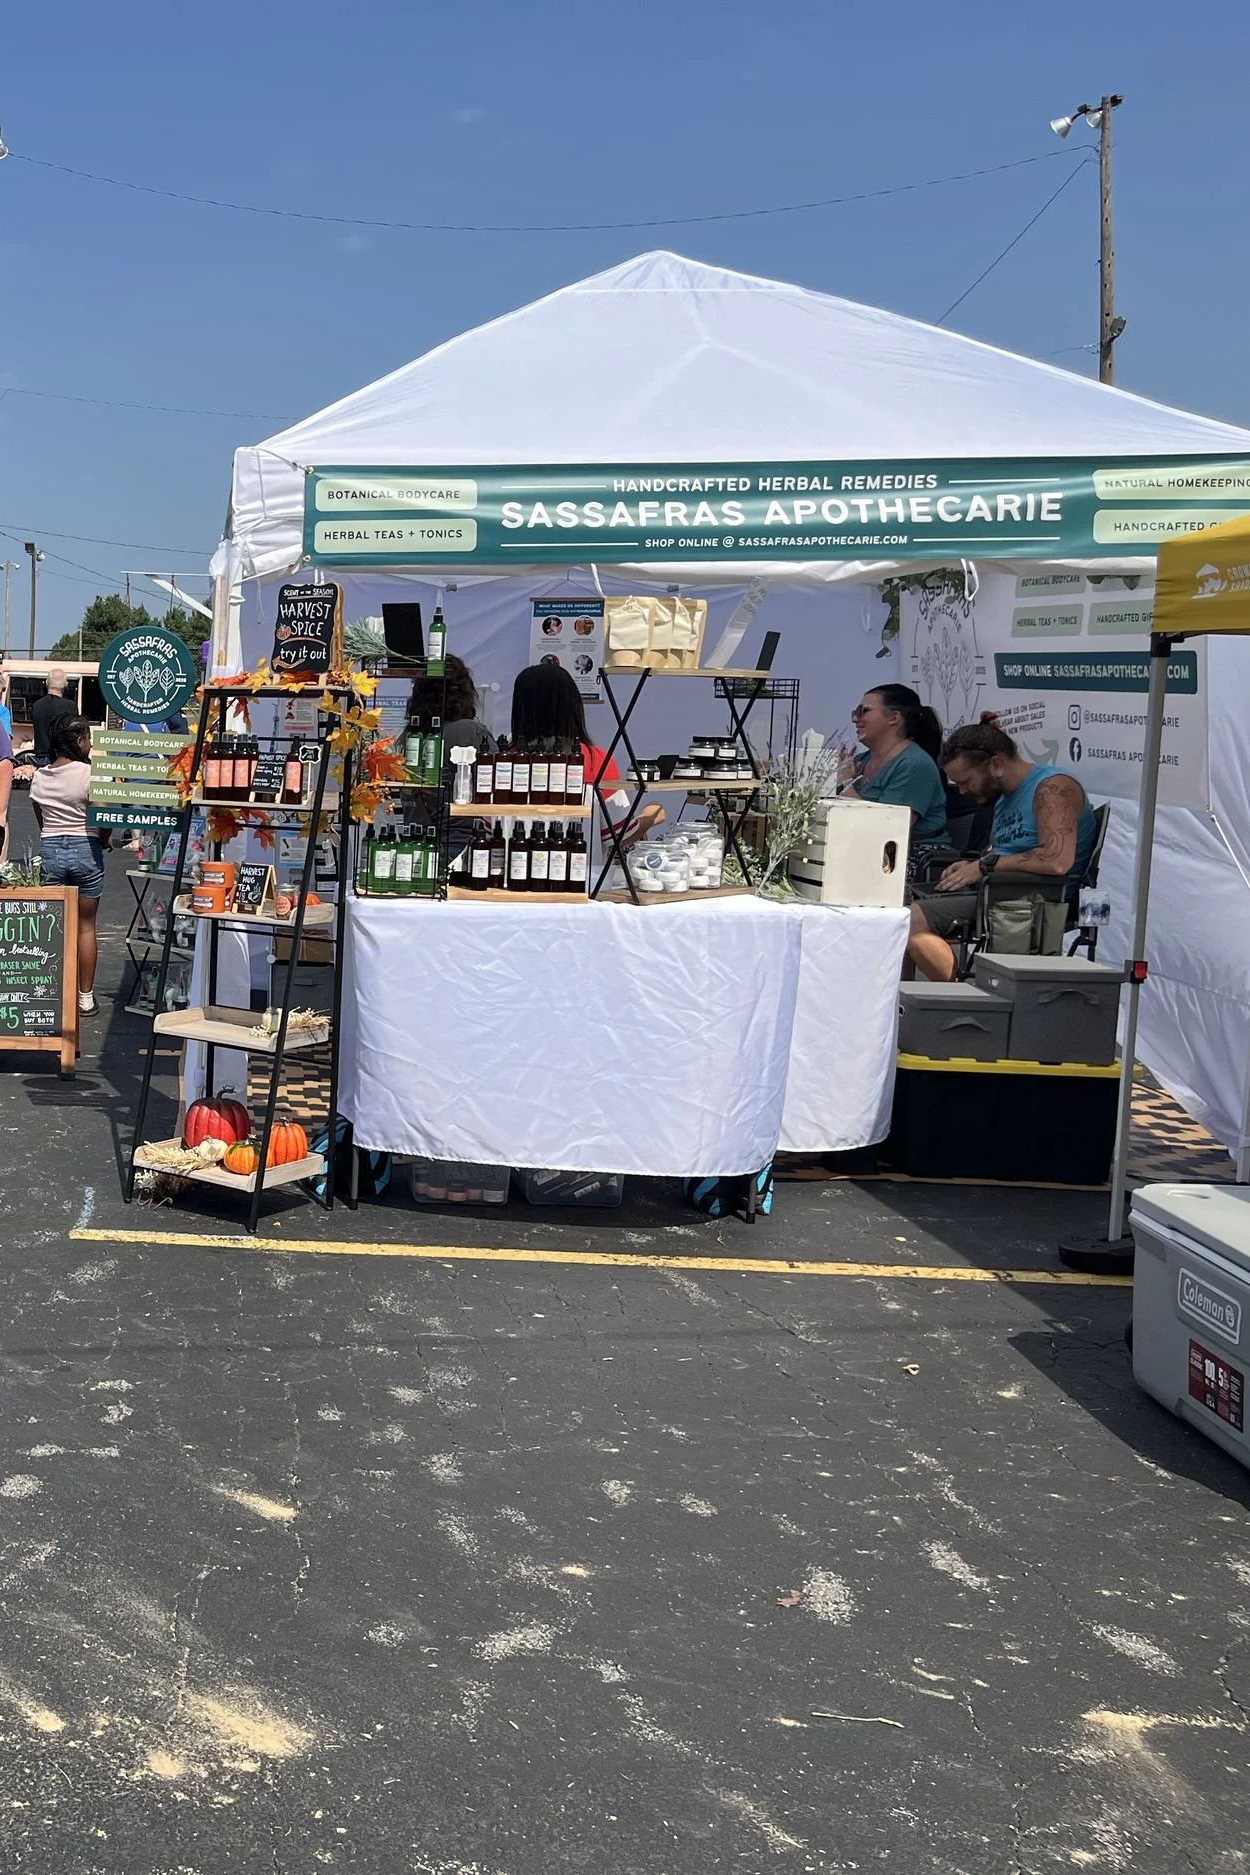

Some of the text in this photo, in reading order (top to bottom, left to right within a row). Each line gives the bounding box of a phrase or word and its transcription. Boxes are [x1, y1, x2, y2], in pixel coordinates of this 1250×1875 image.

[613, 474, 938, 492] HANDCRAFTED HERBAL REMEDIES
[1105, 478, 1163, 489] NATURAL
[327, 489, 460, 500] BOTANICAL BODYCARE
[501, 492, 1064, 528] SASSAFRAS APOTHECARIE
[1114, 521, 1205, 532] HANDCRAFTED
[323, 528, 463, 541] HERBAL TEAS + TONICS
[644, 535, 908, 548] SHOP ONLINE @ SASSAFRASAPOTHECARIE.COM
[1021, 574, 1081, 588] BOTANICAL BODYCARE
[280, 601, 331, 619] HARVEST
[1016, 617, 1037, 628] HERBAL
[1038, 616, 1051, 627] TEAS
[1058, 615, 1078, 626] TONICS
[1096, 613, 1140, 624] HANDCRAFTED
[291, 620, 325, 637] SPICE
[119, 635, 178, 659] SASSAFRAS
[127, 650, 168, 665] APOTHECARIE
[280, 645, 327, 663] try it out
[1003, 664, 1023, 677] SHOP
[1024, 664, 1052, 677] ONLINE
[120, 699, 170, 715] HERBAL REMEDIES
[126, 696, 164, 708] HANDCRAFTED
[1028, 700, 1046, 711] SOCIAL
[1014, 713, 1030, 724] ABOUT
[1030, 710, 1046, 721] SALES
[1019, 721, 1043, 733] PRODUCTS
[99, 736, 185, 749] BOTANICAL BODYCARE
[1087, 747, 1126, 761] SASSAFRAS
[96, 762, 126, 771] HERBAL
[128, 764, 148, 772] TEAS
[93, 788, 127, 797] NATURAL
[96, 812, 124, 823] FREE
[127, 814, 178, 826] SAMPLES
[241, 866, 266, 876] HARVEST
[242, 876, 256, 884] HUG
[238, 883, 251, 892] TEA
[5, 901, 21, 915] BUGS
[22, 901, 39, 914] STILL
[8, 943, 56, 965] bestselling
[21, 960, 41, 971] SALVE
[6, 976, 28, 985] INSECT
[31, 975, 53, 985] SPRAY
[0, 1006, 20, 1029] $5
[1183, 1277, 1224, 1322] Coleman
